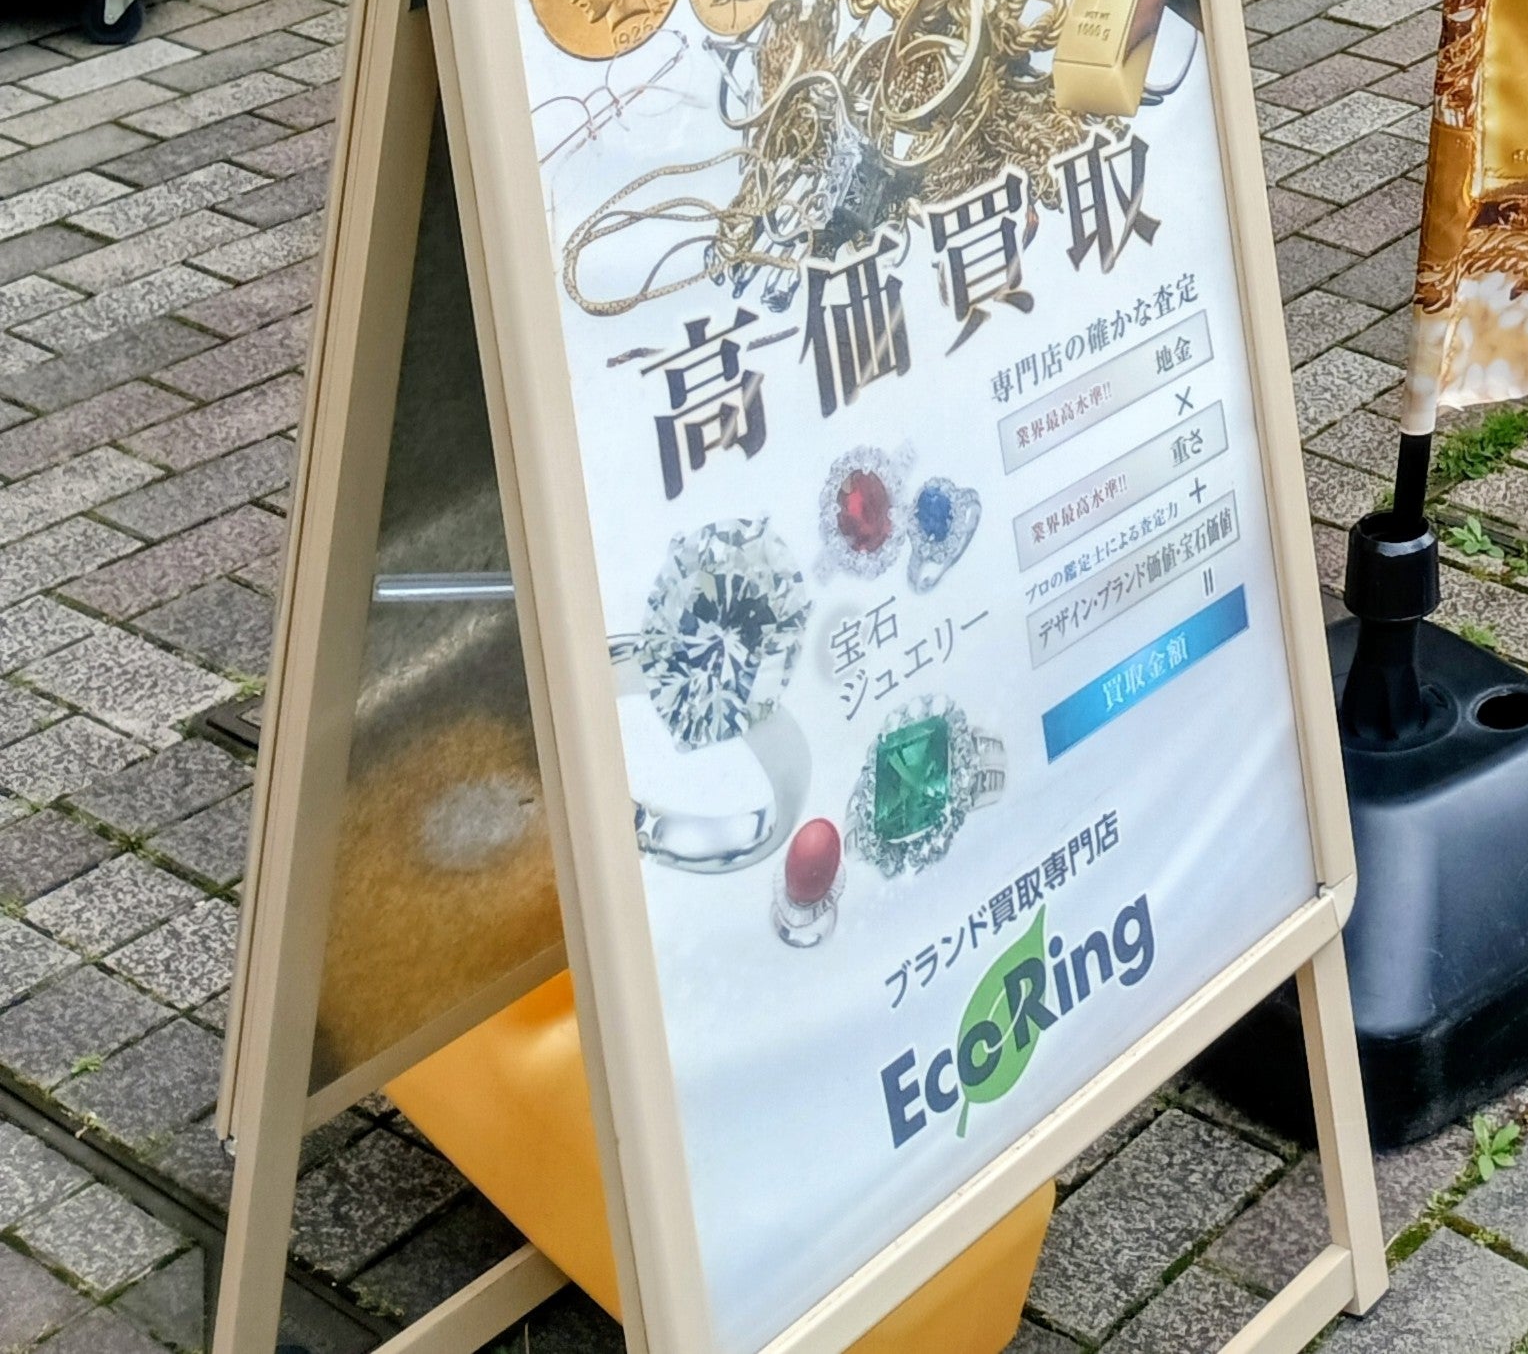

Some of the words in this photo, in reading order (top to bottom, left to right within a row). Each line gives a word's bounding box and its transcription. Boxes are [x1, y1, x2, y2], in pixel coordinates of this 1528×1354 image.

[607, 130, 1161, 501] 高価買取
[990, 272, 1199, 404] 専門店の確かな査定
[1154, 336, 1193, 375] 地金
[1171, 427, 1205, 469] 重さ
[830, 595, 899, 675] 宝石
[839, 609, 990, 722] ジュエリー
[1101, 630, 1190, 712] 買取金額
[884, 809, 1121, 1010] ブランド買取専門店
